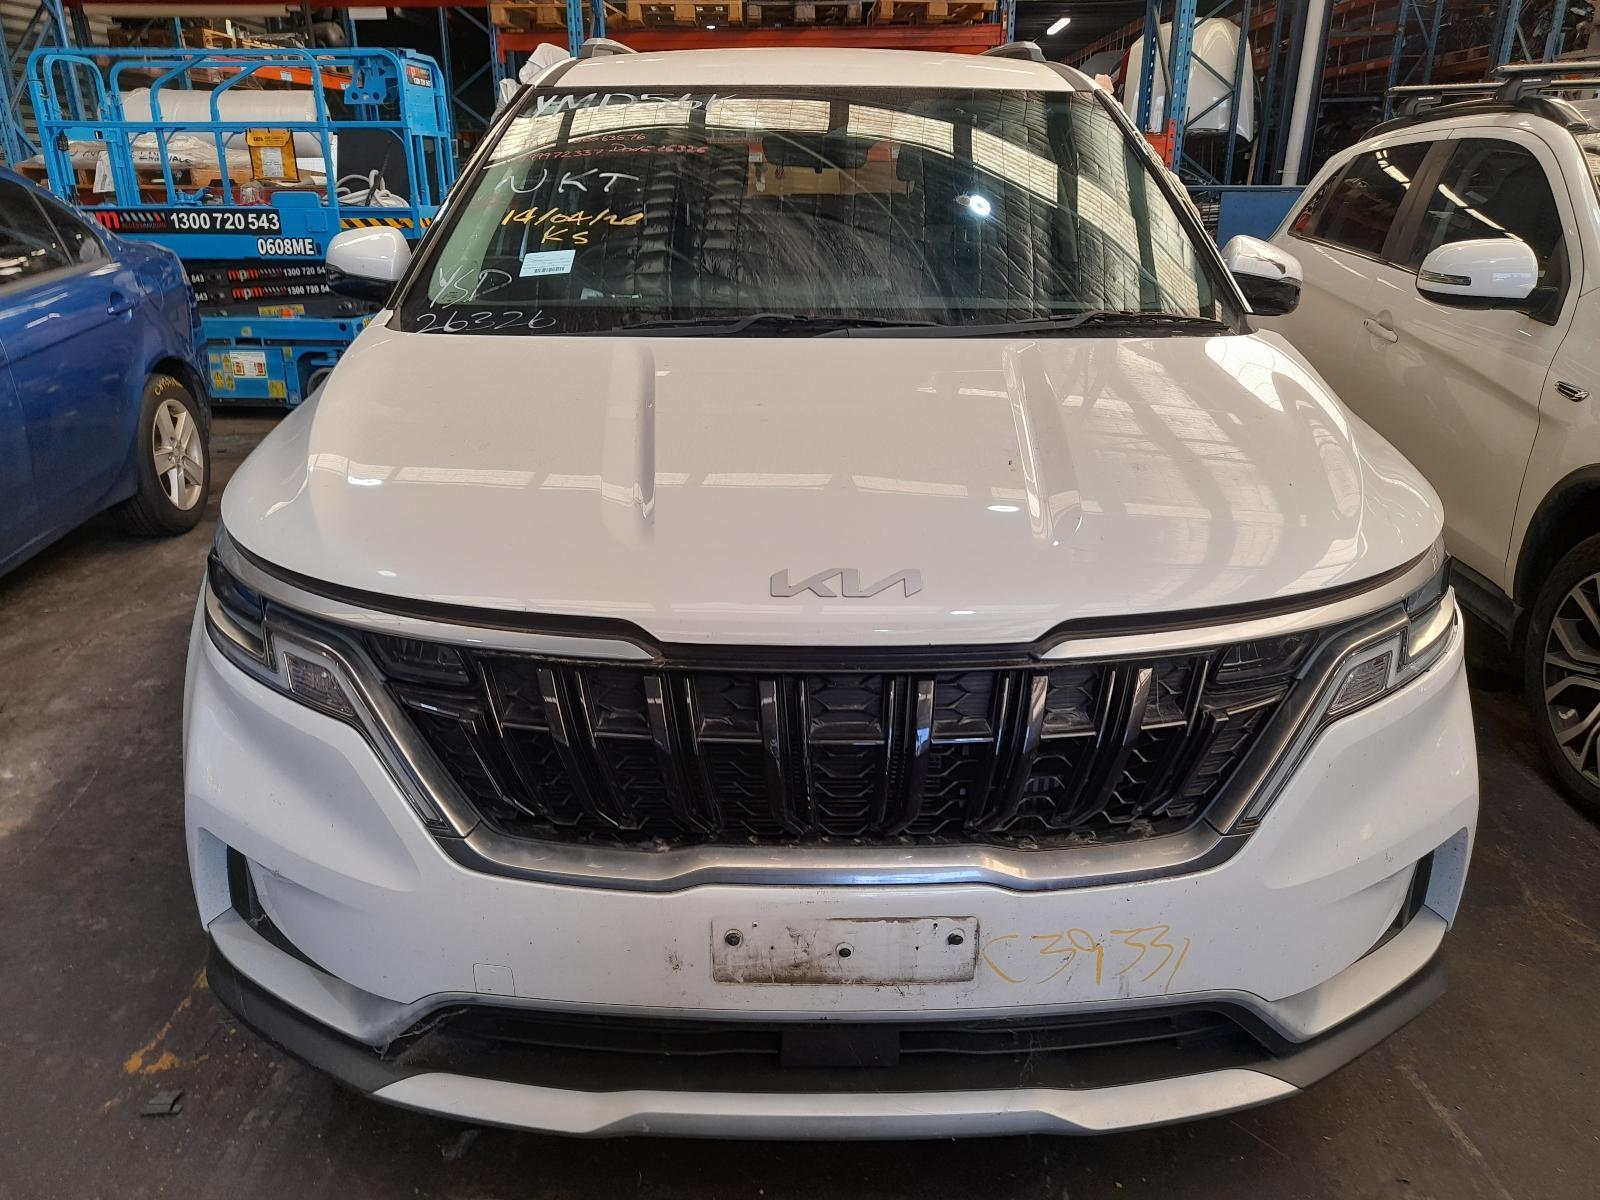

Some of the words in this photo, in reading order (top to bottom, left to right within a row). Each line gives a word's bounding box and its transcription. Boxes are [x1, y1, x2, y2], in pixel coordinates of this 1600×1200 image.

[170, 212, 210, 229] 1300
[213, 213, 245, 229] 720
[249, 213, 280, 230] 543
[257, 238, 315, 256] 0608ME
[227, 268, 259, 282] mpm
[284, 268, 301, 277] 1300
[302, 267, 315, 276] 720
[316, 266, 326, 275] 54
[232, 287, 264, 300] mpm
[287, 286, 305, 295] 1300
[305, 285, 319, 294] 720
[320, 284, 330, 293] 54
